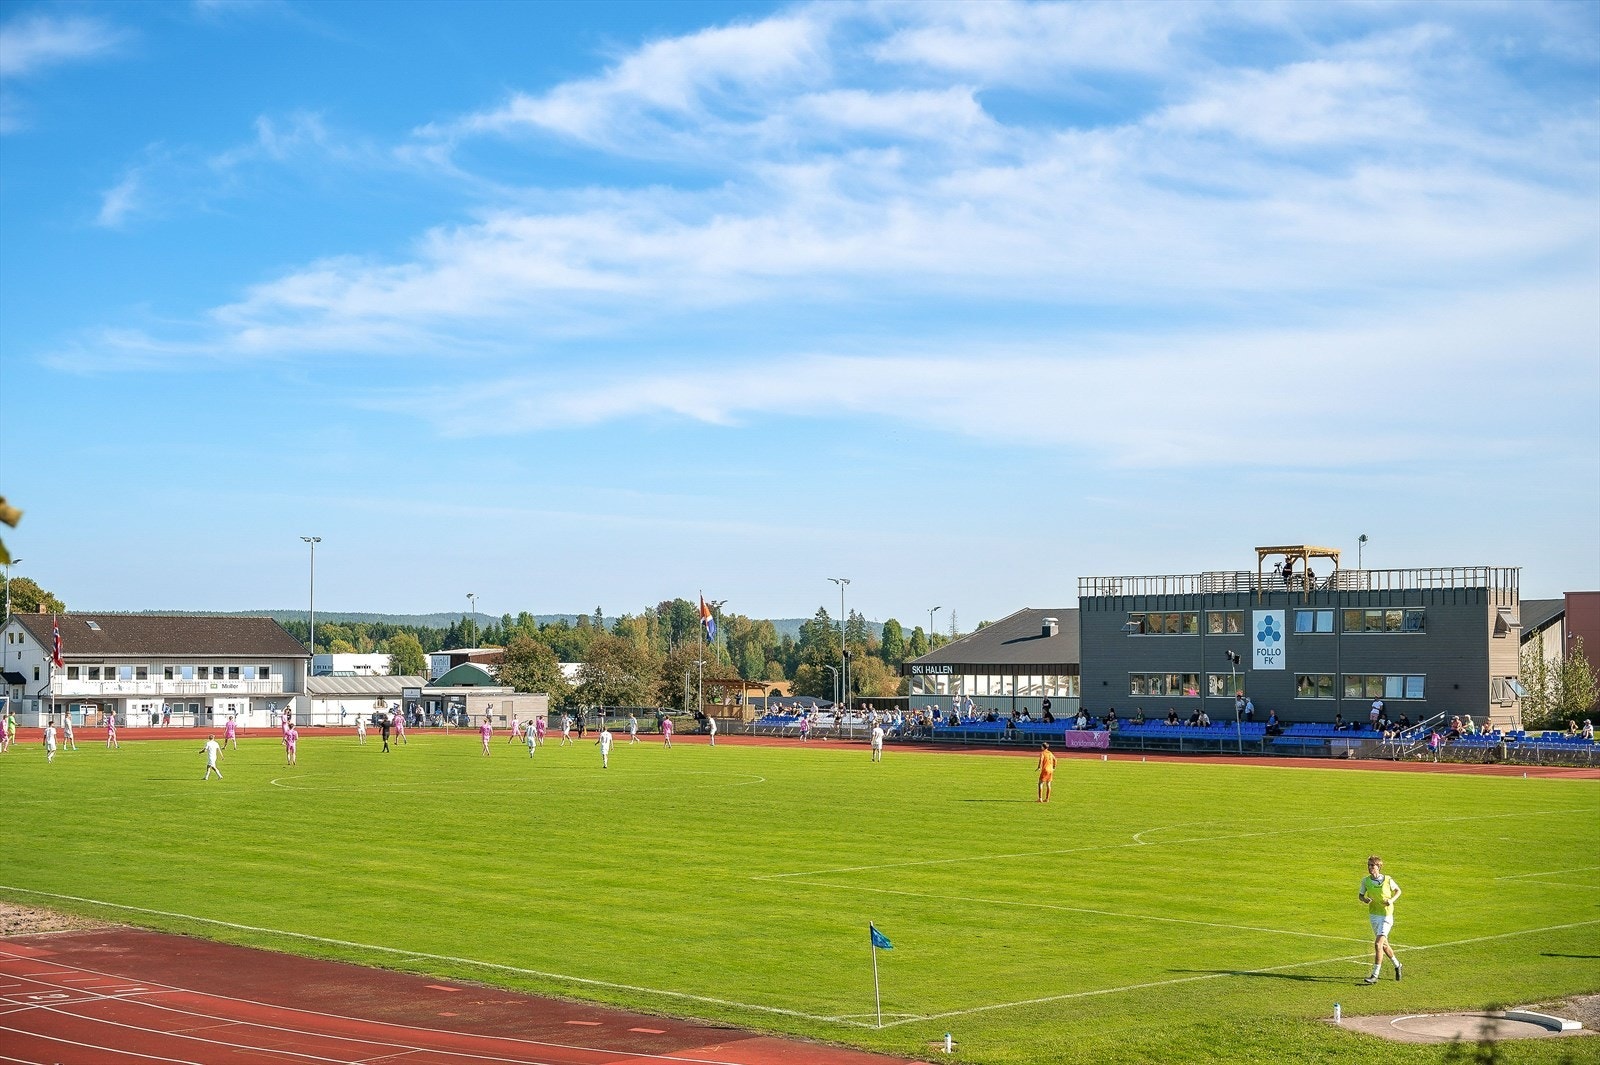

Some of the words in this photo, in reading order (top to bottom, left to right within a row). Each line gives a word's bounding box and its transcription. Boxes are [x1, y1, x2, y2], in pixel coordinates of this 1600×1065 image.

[1256, 648, 1281, 656] FOLLO
[1264, 656, 1274, 665] FK
[912, 665, 924, 674] SKI
[925, 665, 953, 674] HALLEN
